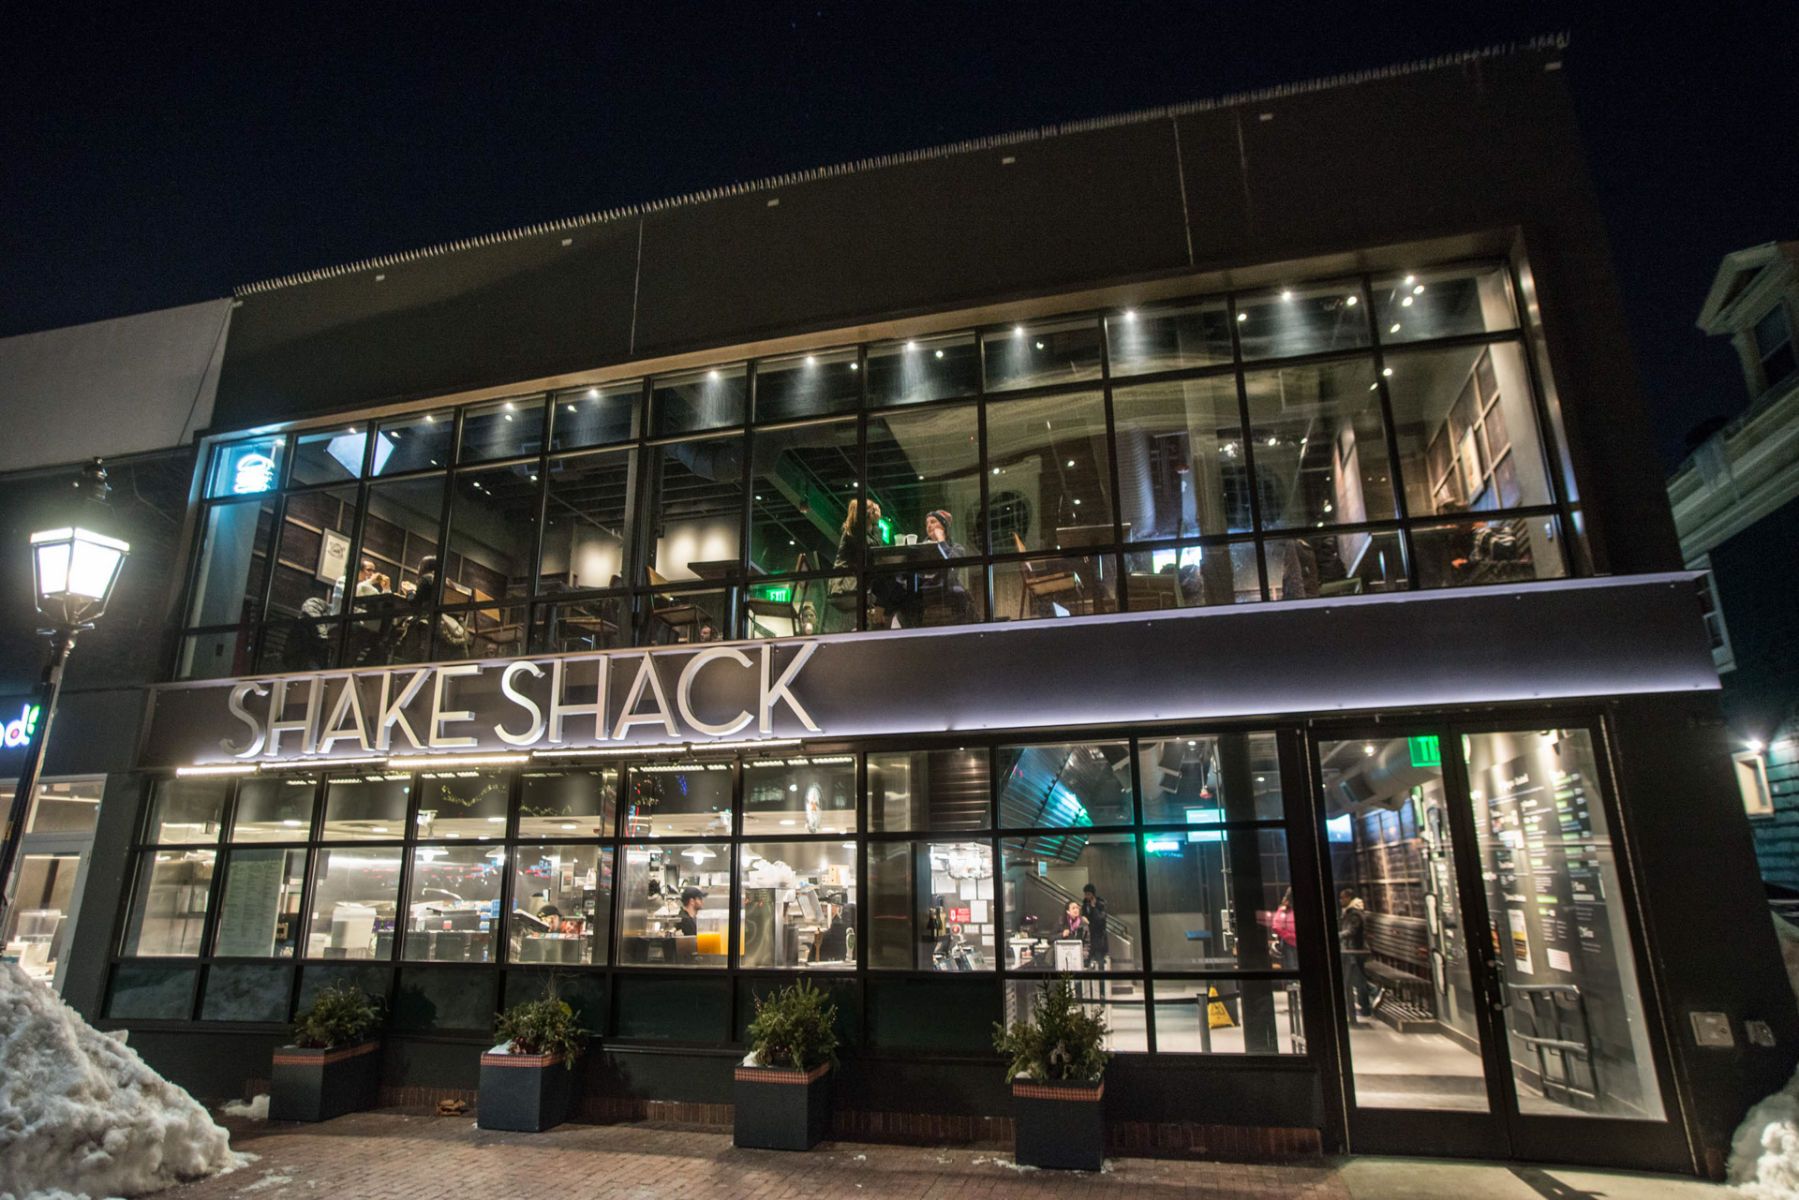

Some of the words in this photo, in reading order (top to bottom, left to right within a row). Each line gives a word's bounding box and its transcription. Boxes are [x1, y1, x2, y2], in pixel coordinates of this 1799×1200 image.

[770, 590, 787, 602] EXIT
[222, 664, 483, 758] SHAKE
[494, 640, 822, 747] SHACK
